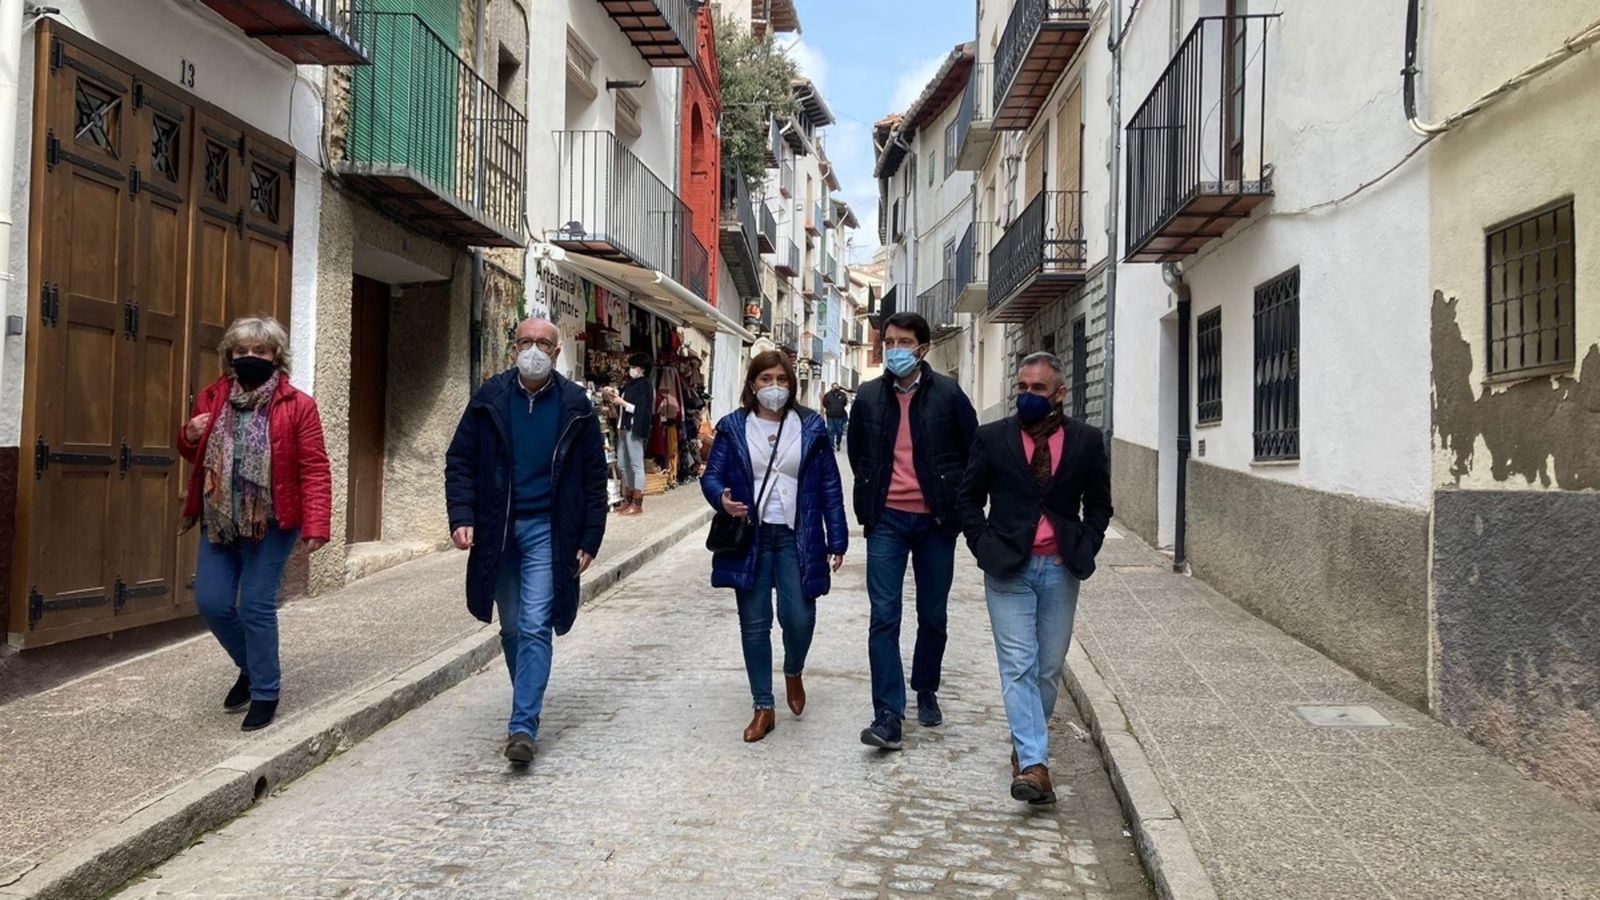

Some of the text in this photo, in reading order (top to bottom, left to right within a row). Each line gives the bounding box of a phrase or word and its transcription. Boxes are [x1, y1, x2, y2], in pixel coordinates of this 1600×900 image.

[180, 59, 195, 88] 13
[535, 281, 579, 318] del Mimbre
